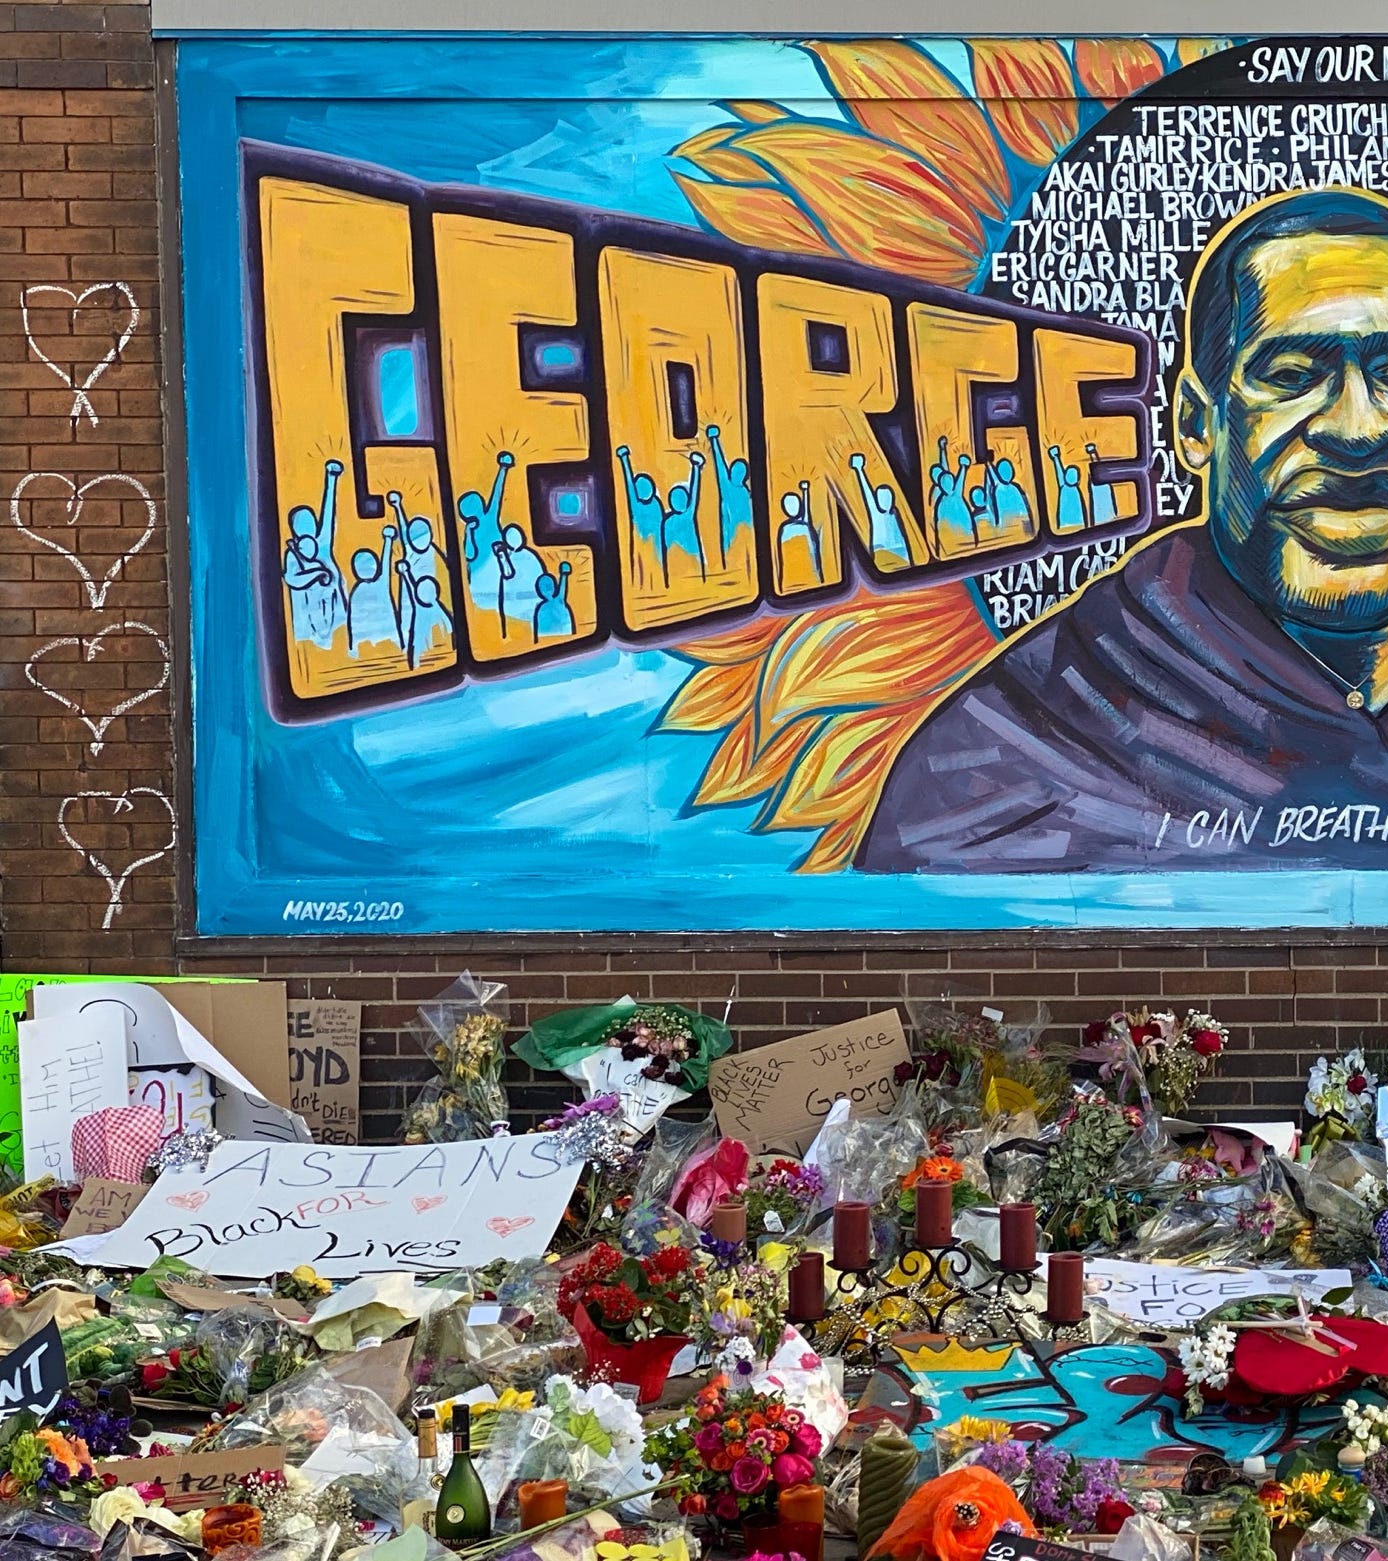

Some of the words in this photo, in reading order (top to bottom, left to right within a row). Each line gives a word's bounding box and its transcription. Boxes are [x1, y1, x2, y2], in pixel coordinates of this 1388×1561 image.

[1249, 46, 1309, 83] SAY
[1315, 44, 1381, 83] OUR
[1132, 104, 1284, 137] TERRENCE
[1044, 161, 1104, 191] AKAI
[1032, 191, 1150, 221] MICHAEL
[1011, 220, 1109, 253] TYISHA
[1121, 220, 1211, 252] MILLE
[1012, 280, 1128, 312] SANDRA
[1134, 281, 1187, 312] BLA
[252, 168, 1142, 706] GEORGE
[1154, 811, 1172, 849] I
[1186, 804, 1264, 850] CAN
[711, 1058, 748, 1104] BLACK
[725, 1065, 762, 1109] LIVES
[735, 1057, 796, 1132] MATTER
[805, 1076, 898, 1116] Georg
[202, 1137, 564, 1189] ASIANS
[296, 1190, 388, 1220] FOR
[144, 1206, 321, 1257] Black
